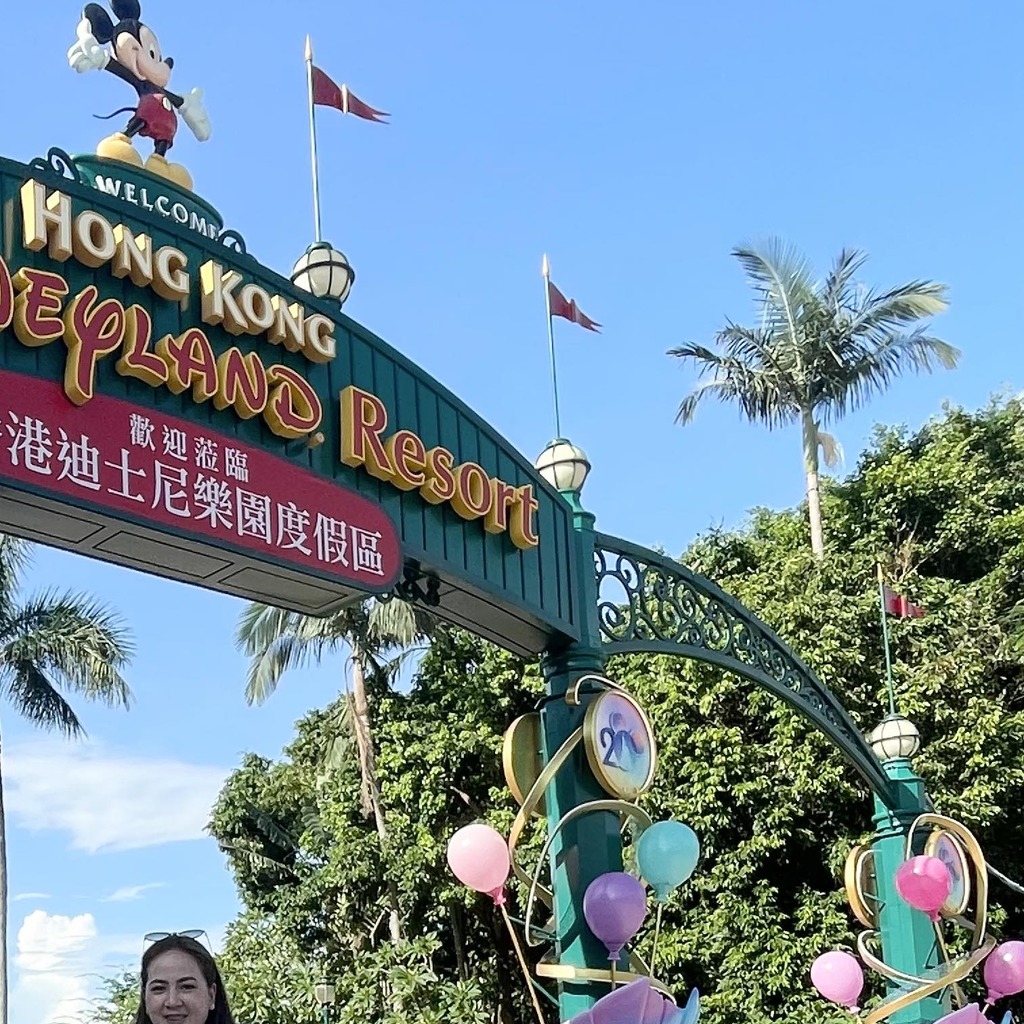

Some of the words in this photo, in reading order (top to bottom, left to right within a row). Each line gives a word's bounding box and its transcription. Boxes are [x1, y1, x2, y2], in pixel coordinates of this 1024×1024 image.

[20, 179, 189, 299] HONG
[200, 259, 336, 362] KONG
[129, 413, 249, 483] 歡迎蒞臨
[340, 386, 539, 549] Resort
